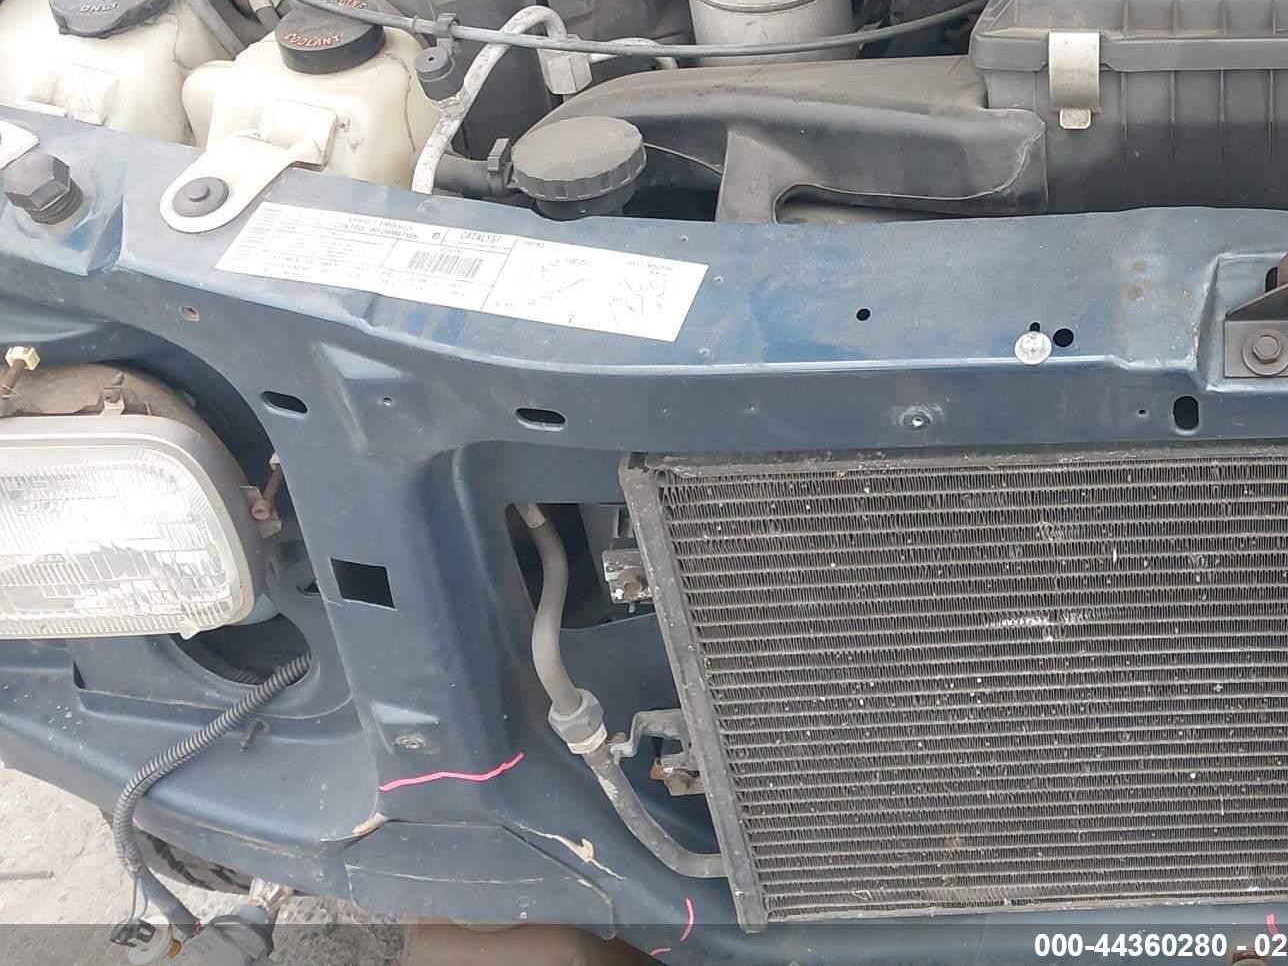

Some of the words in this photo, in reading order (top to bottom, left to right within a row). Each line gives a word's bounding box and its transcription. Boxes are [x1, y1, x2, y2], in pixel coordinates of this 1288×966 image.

[80, 2, 119, 13] ONLY
[284, 33, 341, 48] COOLANT
[459, 231, 503, 244] CATALYST
